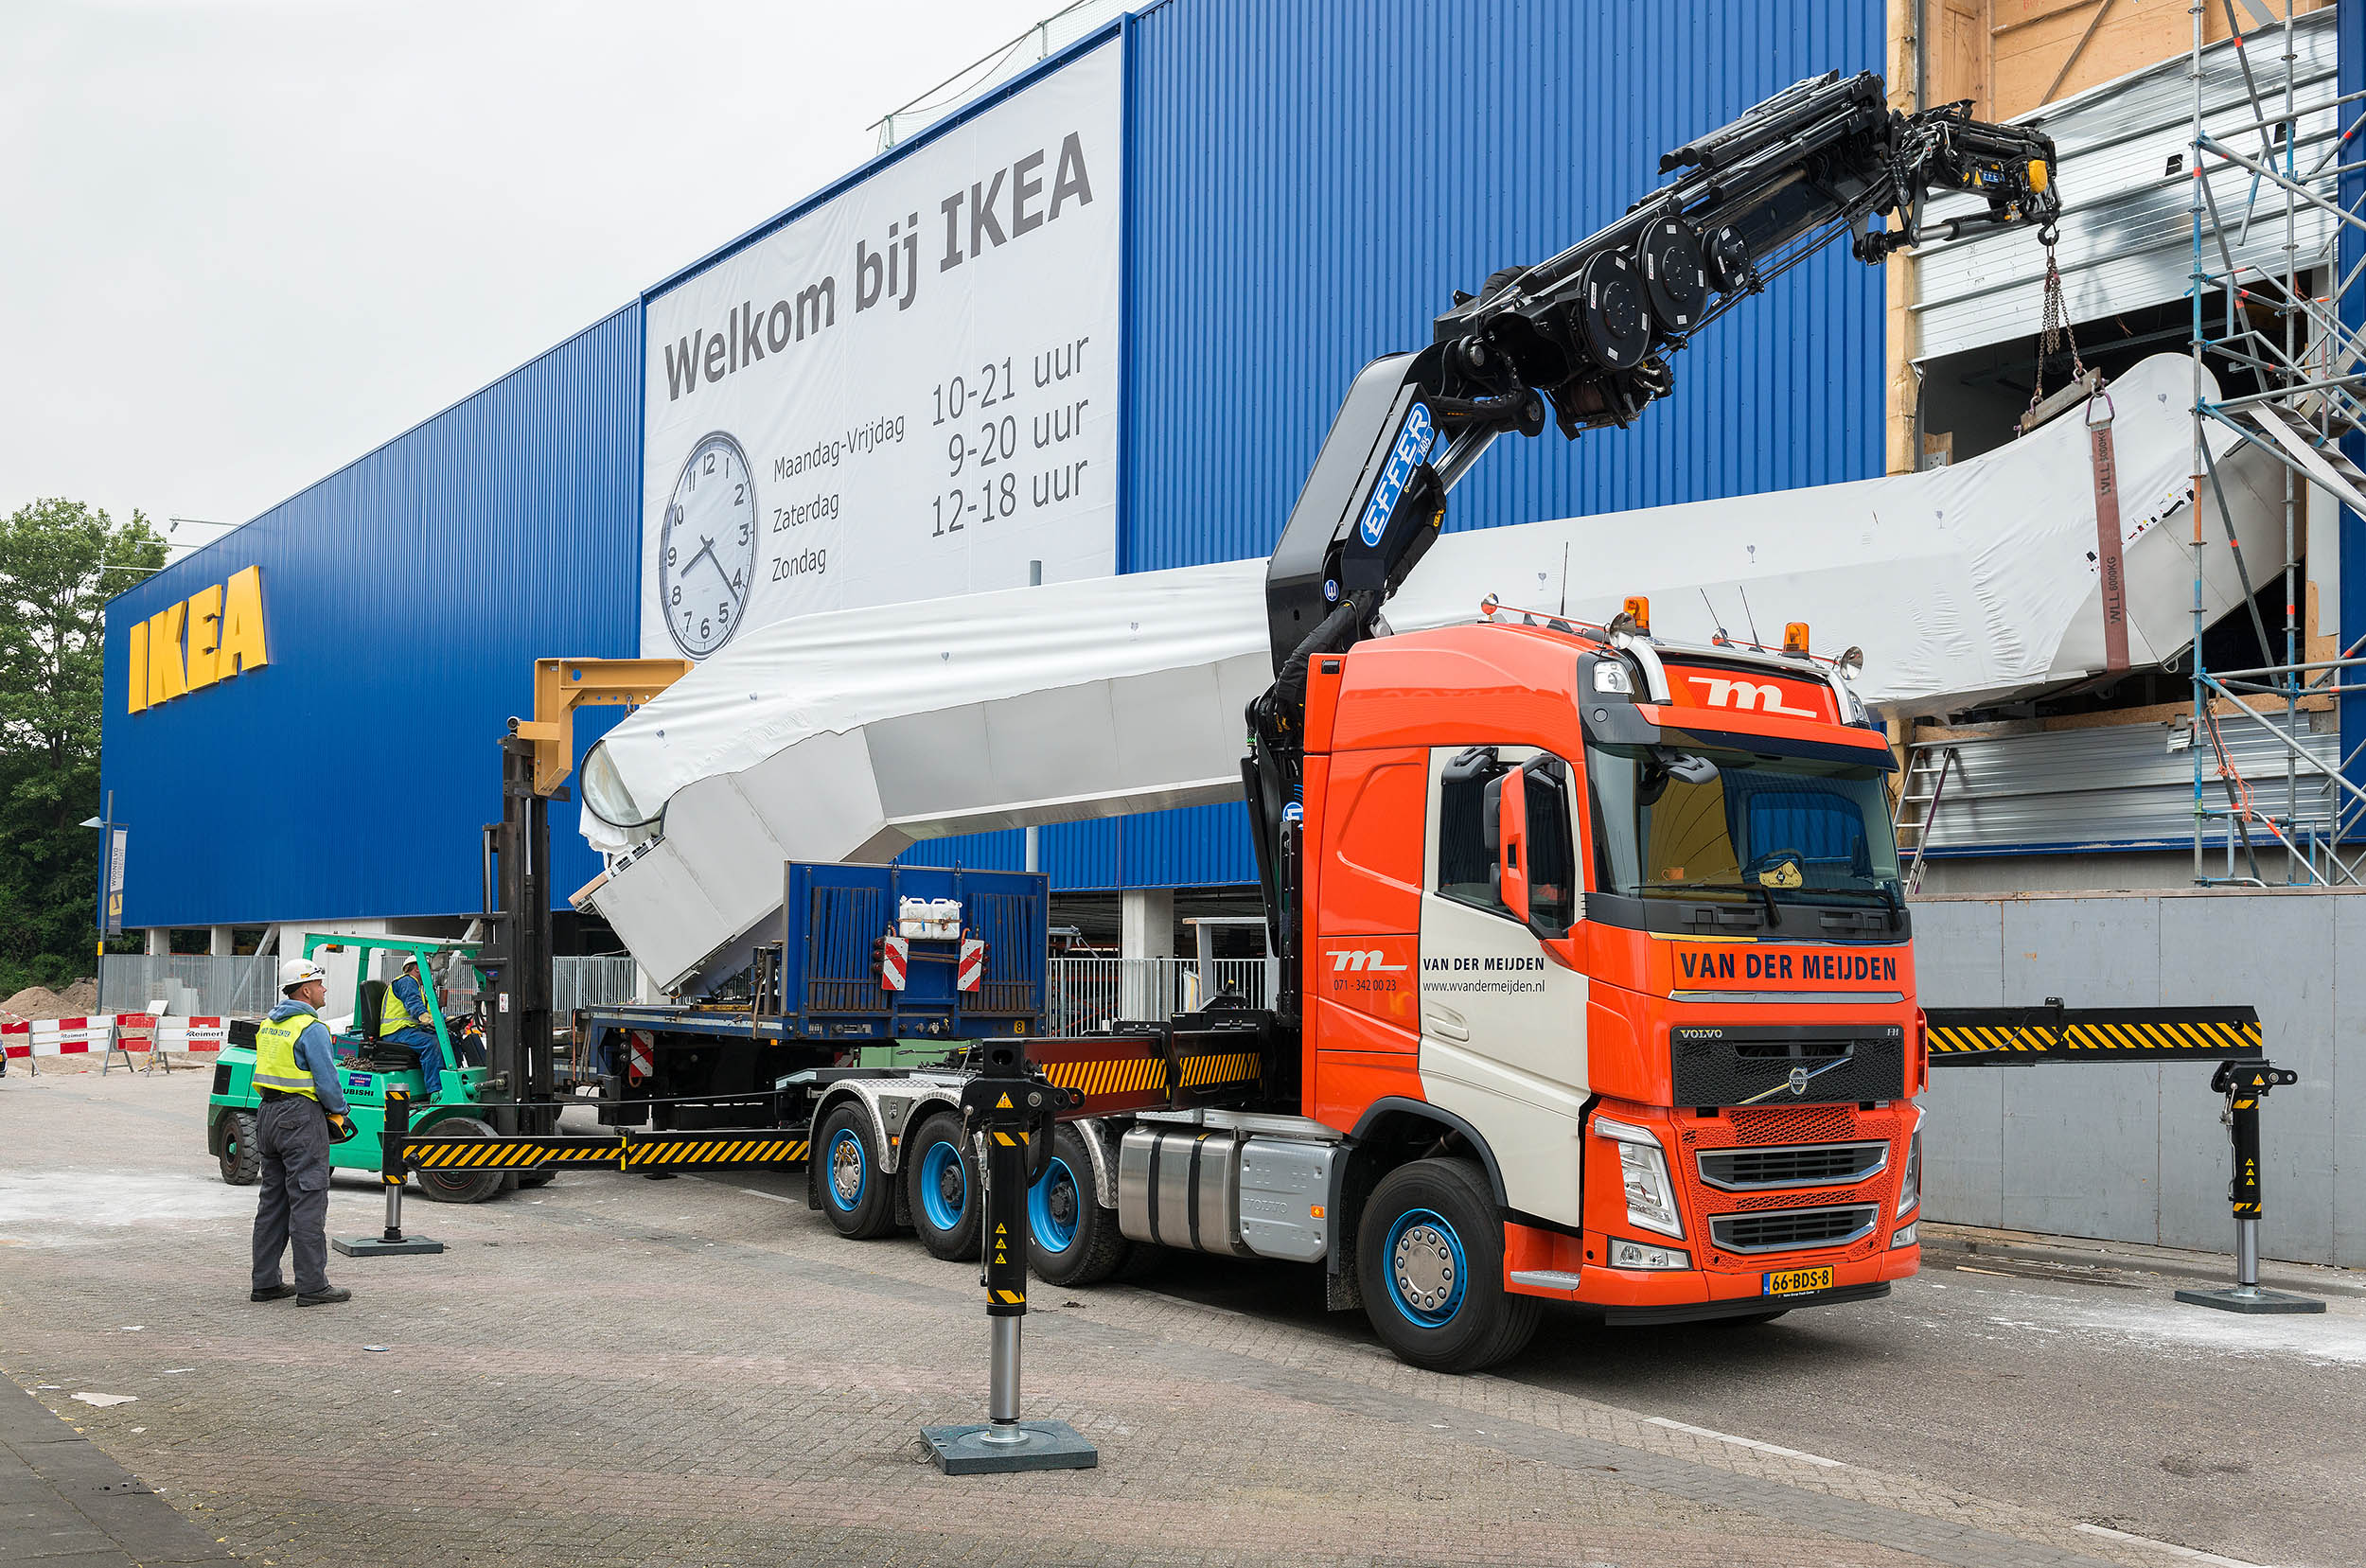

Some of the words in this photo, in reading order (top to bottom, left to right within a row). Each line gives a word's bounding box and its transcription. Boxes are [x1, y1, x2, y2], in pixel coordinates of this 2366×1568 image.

[664, 275, 836, 402] Welkom
[856, 211, 918, 313] bij
[940, 131, 1093, 273] IKEA
[932, 356, 1015, 427] 10-21
[1033, 336, 1089, 388] uur
[773, 414, 905, 484] Maandag-Vrijdag
[948, 414, 1016, 478] 9-20
[1033, 398, 1089, 449] uur
[1418, 435, 1431, 457] 1405
[703, 452, 715, 477] 12
[725, 457, 730, 480] 1
[1364, 408, 1428, 537] EFFER
[688, 469, 696, 493] 11
[733, 483, 745, 507] 2
[932, 472, 1016, 537] 12-18
[1033, 459, 1088, 508] uur
[674, 503, 684, 527] 10
[772, 493, 839, 534] Zaterdag
[738, 522, 750, 547] 3
[667, 546, 678, 568] 9
[772, 547, 826, 583] Zondag
[732, 567, 743, 590] 4
[2109, 555, 2117, 591] 6000KG
[671, 585, 681, 607] 8
[717, 602, 729, 625] 5
[2110, 592, 2121, 625] WLL
[683, 610, 693, 633] 7
[700, 617, 710, 640] 6
[128, 564, 269, 714] IKEA
[1423, 958, 1449, 971] VAN
[1454, 958, 1479, 971] DER
[1484, 957, 1545, 972] MEIJDEN
[1680, 953, 1735, 978] VAN
[1746, 954, 1793, 979] DER
[1802, 955, 1897, 981] MEIJDEN
[1333, 978, 1348, 992] 071
[1355, 979, 1371, 992] 342
[1372, 979, 1385, 992] 00
[1386, 979, 1397, 992] 23
[1422, 978, 1545, 995] www.wvandermeijden.nl
[188, 1030, 224, 1038] Reimert
[1015, 1021, 1023, 1032] 8
[1680, 1029, 1723, 1039] VOLVO
[343, 1088, 375, 1097] UBISHI
[1772, 1269, 1829, 1292] 66-BDS-8
